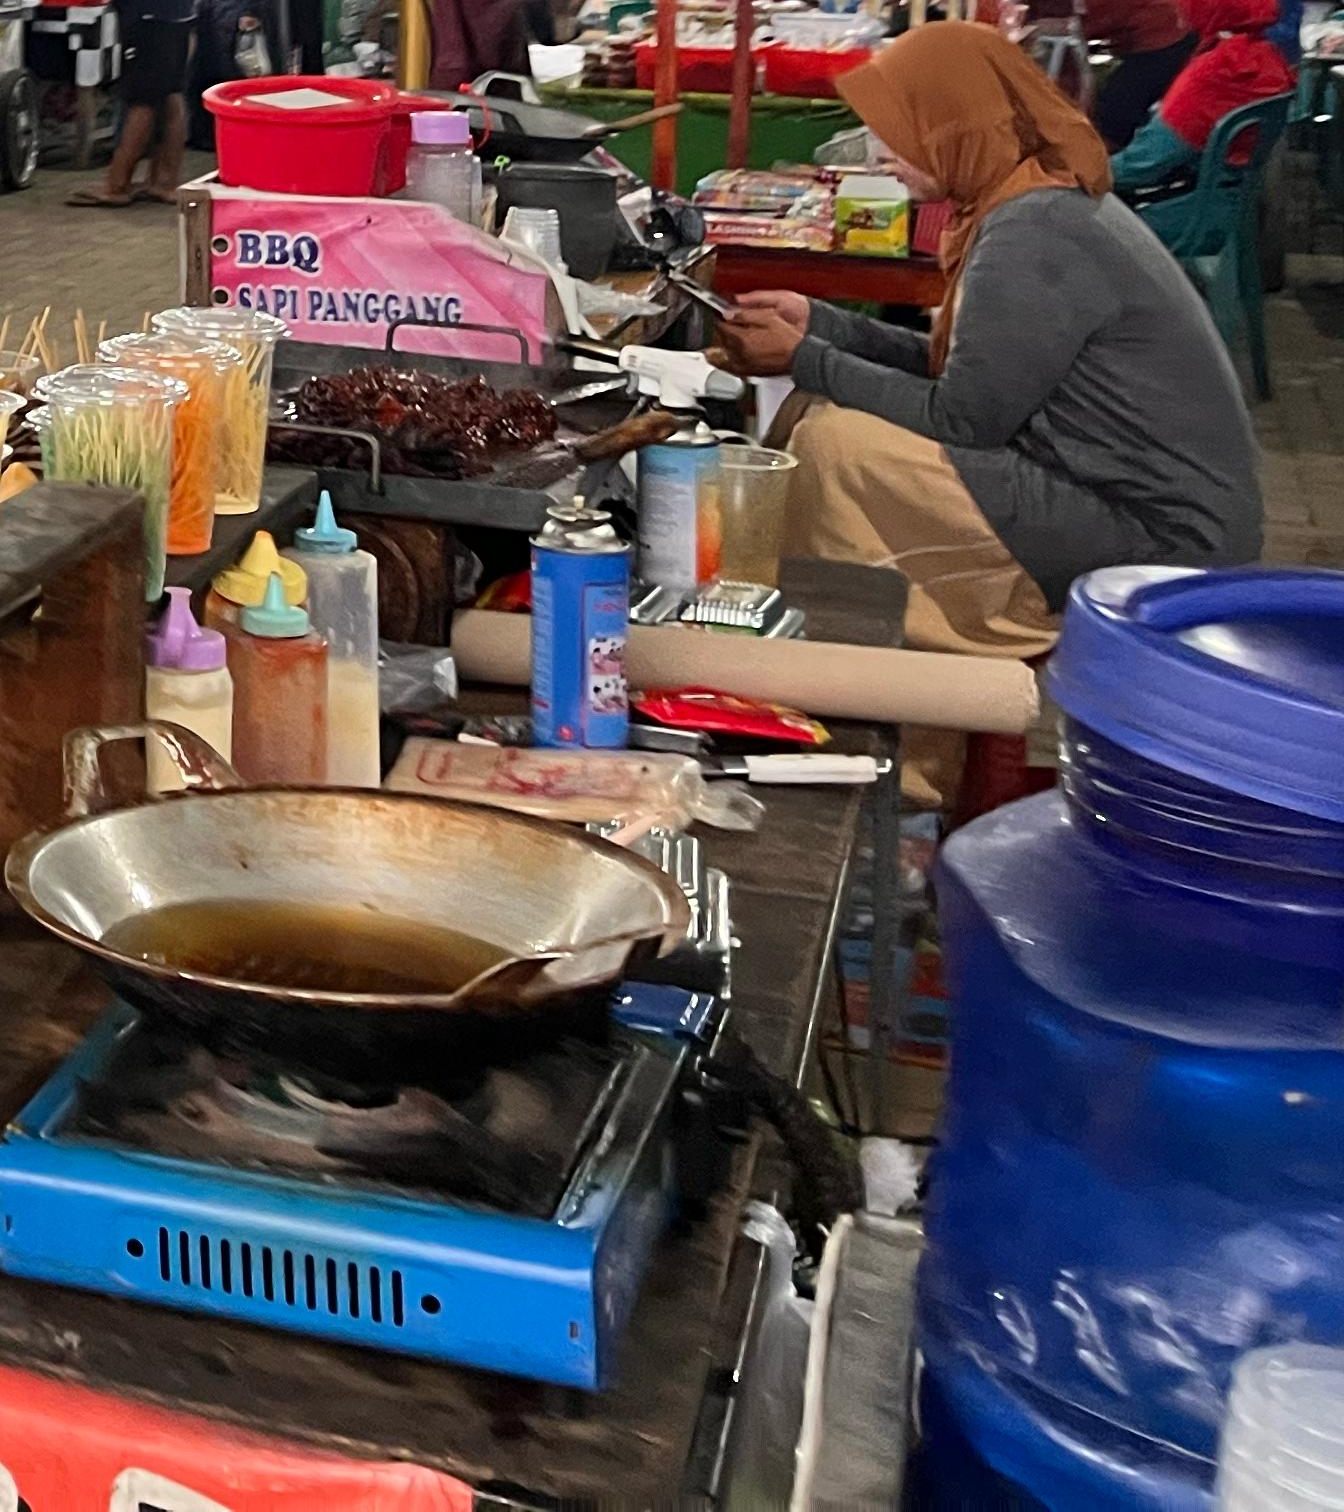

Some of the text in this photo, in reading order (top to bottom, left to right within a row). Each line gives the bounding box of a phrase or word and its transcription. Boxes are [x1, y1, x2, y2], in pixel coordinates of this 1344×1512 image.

[237, 231, 321, 275] BBQ
[238, 285, 464, 325] SAPI PANGGANG
